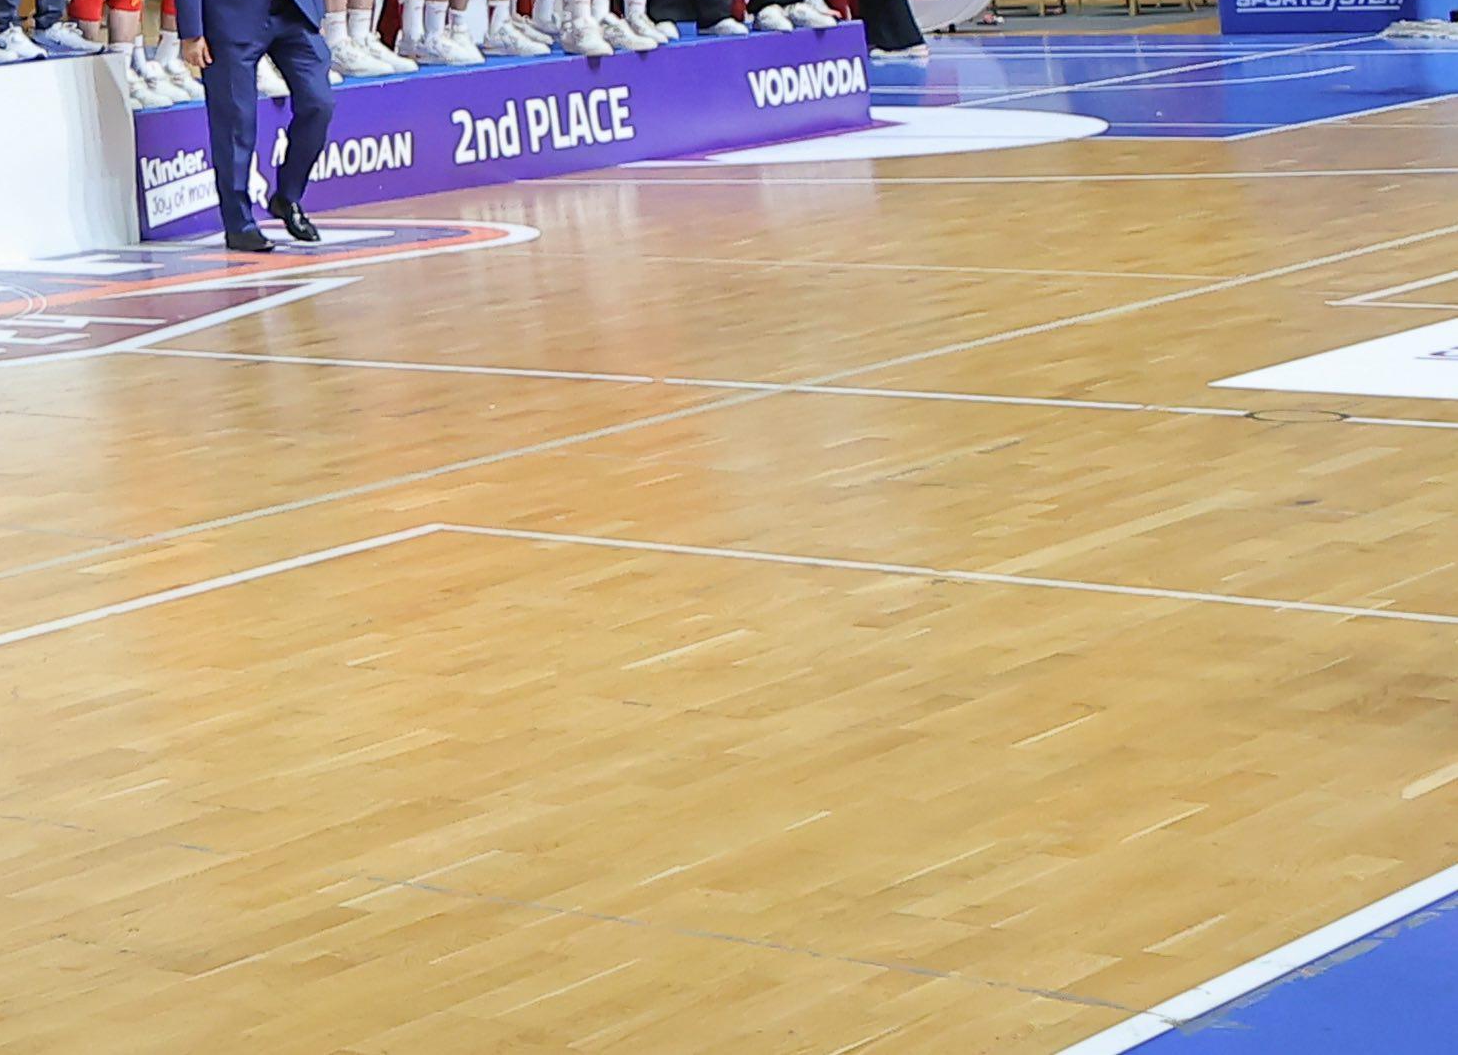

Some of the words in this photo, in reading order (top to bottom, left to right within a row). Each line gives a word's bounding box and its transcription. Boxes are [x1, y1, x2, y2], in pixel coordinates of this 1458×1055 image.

[746, 56, 868, 109] VODAVODA
[452, 97, 521, 165] 2nd
[525, 84, 634, 154] PLACE
[150, 192, 173, 215] Joy
